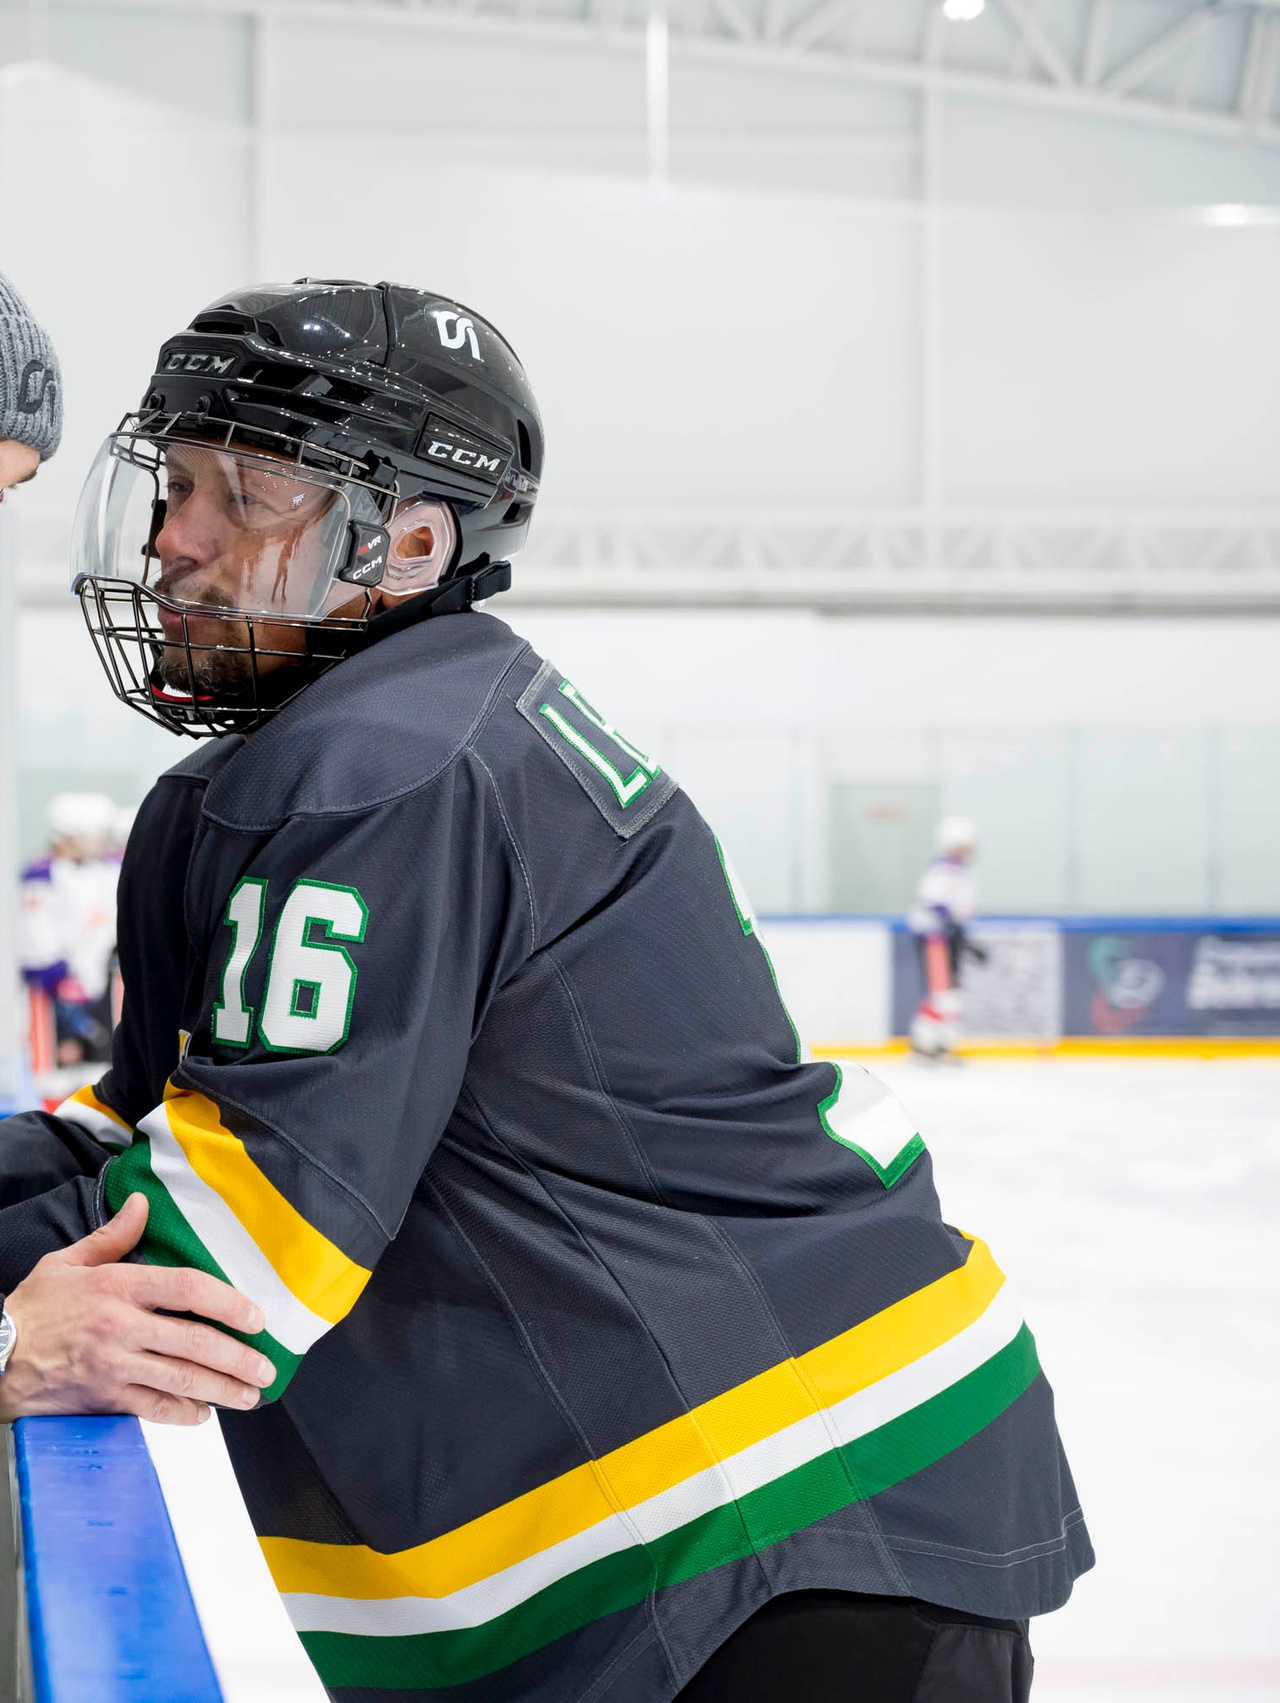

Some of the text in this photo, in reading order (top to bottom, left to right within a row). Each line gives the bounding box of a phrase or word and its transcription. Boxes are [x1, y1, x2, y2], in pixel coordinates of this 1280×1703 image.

[165, 353, 236, 374] CCM
[427, 441, 501, 472] CCM
[352, 555, 383, 580] CCM
[211, 875, 370, 1056] 16
